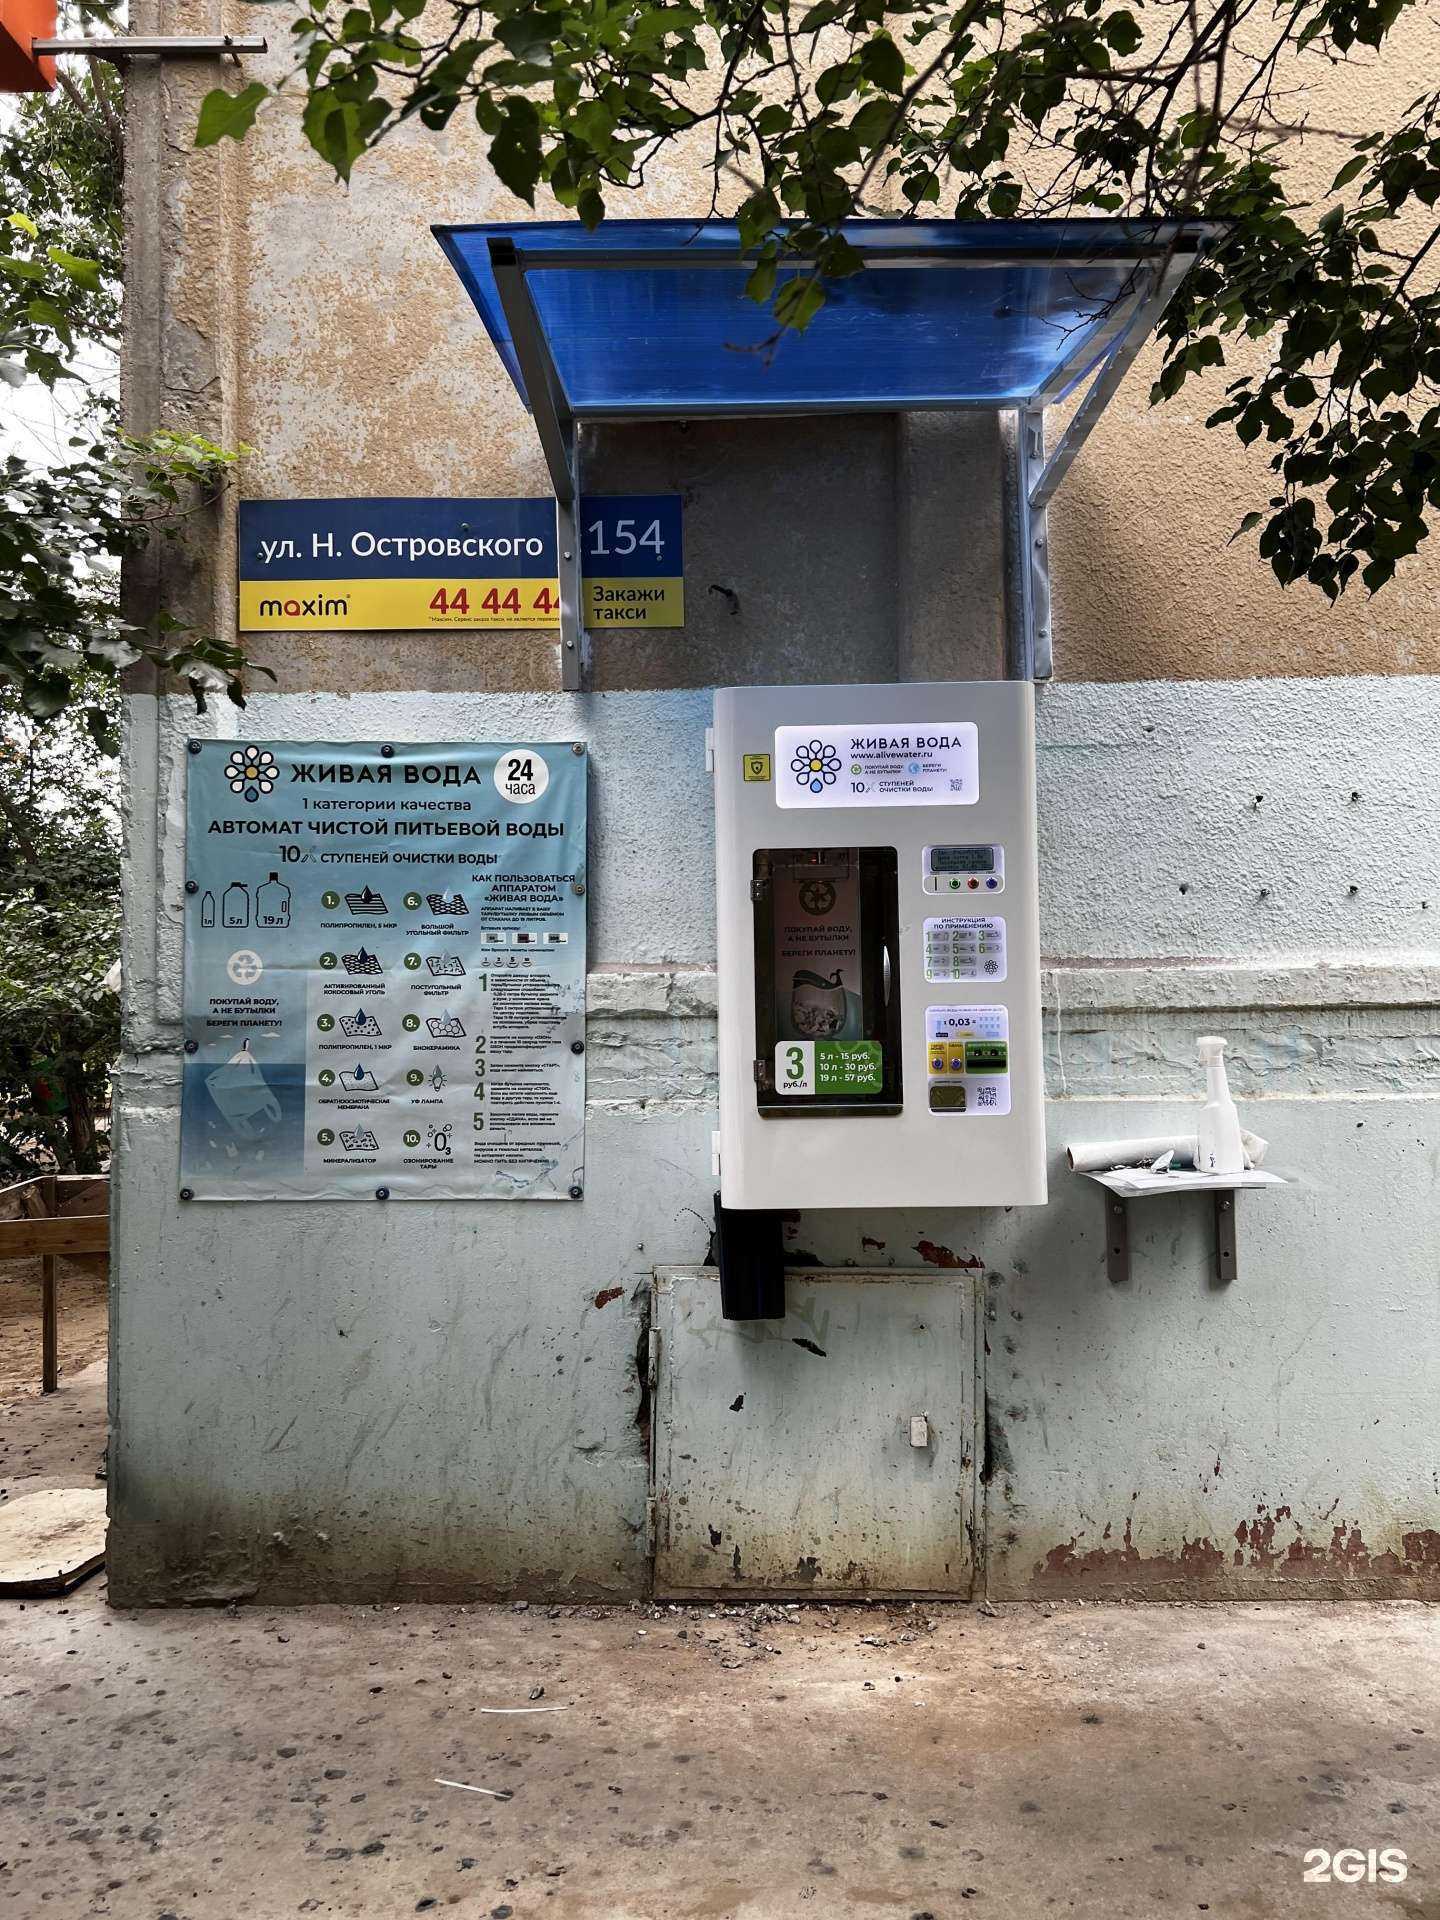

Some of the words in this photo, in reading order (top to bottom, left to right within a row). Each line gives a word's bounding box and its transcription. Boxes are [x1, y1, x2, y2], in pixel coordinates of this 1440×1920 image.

[587, 519, 666, 556] 154
[261, 537, 302, 564] ул.
[312, 533, 343, 557] Н.
[351, 531, 543, 561] Островского
[429, 587, 470, 614] 44
[481, 587, 522, 614] 44
[592, 586, 666, 605] Закажи
[259, 593, 349, 616] maxim
[592, 605, 648, 621] такси
[850, 737, 910, 751] ЖИВАЯ
[916, 736, 962, 750] ВОДА
[850, 751, 934, 759] www.alivewater.ru
[290, 763, 393, 784] ЖИВАЯ
[404, 765, 482, 788] ВОДА
[507, 758, 534, 782] 24
[850, 781, 865, 794] 10
[878, 779, 915, 787] СТУПЕНЕЙ
[505, 783, 536, 796] часа
[302, 797, 309, 810] 1
[313, 799, 396, 812] категории
[400, 800, 472, 811] качества
[208, 820, 303, 835] АВТОМАТ
[308, 818, 388, 836] ЧИСТОЙ
[394, 819, 500, 837] ПИТЬЕВОЙ
[506, 822, 564, 839] ВОДЫ
[279, 845, 301, 864] 10
[320, 850, 389, 864] СТУПЕНЕЙ
[392, 853, 455, 865] ОЧИСТКИ
[458, 854, 498, 867] ВОДЫ
[491, 884, 556, 892] АППАРАТОМ
[326, 895, 335, 906] 1.
[406, 896, 419, 907] 6.
[484, 894, 527, 902] «ЖИВАЯ
[529, 894, 564, 903] ВОДА»
[320, 922, 377, 930] ПОЛИПРОПИЛЕН,
[421, 922, 454, 930] БОЛЬШОЙ
[784, 924, 826, 934] ПОКУПАЙ
[794, 934, 808, 942] НЕ
[952, 931, 960, 942] 2
[978, 930, 986, 941] 3
[782, 949, 814, 957] БЕРЕГИ
[814, 949, 856, 957] ПЛАНЕТУ!
[925, 944, 932, 955] 4
[952, 943, 959, 955] 5
[978, 943, 986, 954] 6
[323, 956, 334, 967] 2.
[407, 957, 418, 967] 7.
[410, 983, 462, 991] ПОСТУГОЛЬНЫЙ
[478, 973, 488, 992] 1
[209, 996, 251, 1006] ПОКУПАЙ
[253, 998, 280, 1007] ВОДУ,
[234, 1007, 276, 1015] БУТЫЛКИ
[206, 1019, 239, 1027] БЕРЕГИ
[240, 1019, 282, 1028] ПЛАНЕТУ!
[320, 1018, 332, 1028] 3.
[406, 1018, 417, 1028] 8.
[948, 1018, 971, 1028] 0,03
[475, 1035, 487, 1054] 2
[820, 1052, 826, 1061] 5
[827, 1053, 834, 1061] л
[841, 1052, 850, 1061] 15
[851, 1052, 870, 1062] руб.
[475, 1058, 486, 1077] 3
[785, 1046, 805, 1080] 3
[820, 1063, 830, 1071] 10
[845, 1063, 857, 1071] 30
[858, 1062, 877, 1073] руб.
[321, 1073, 332, 1084] 4.
[410, 1073, 420, 1083] 9.
[820, 1074, 830, 1082] 19
[844, 1073, 856, 1082] 57
[857, 1074, 876, 1083] руб.
[783, 1080, 808, 1089] руб./л
[473, 1082, 486, 1101] 4
[473, 1112, 485, 1131] 5
[320, 1132, 331, 1142] 5.
[405, 1133, 419, 1143] 10.
